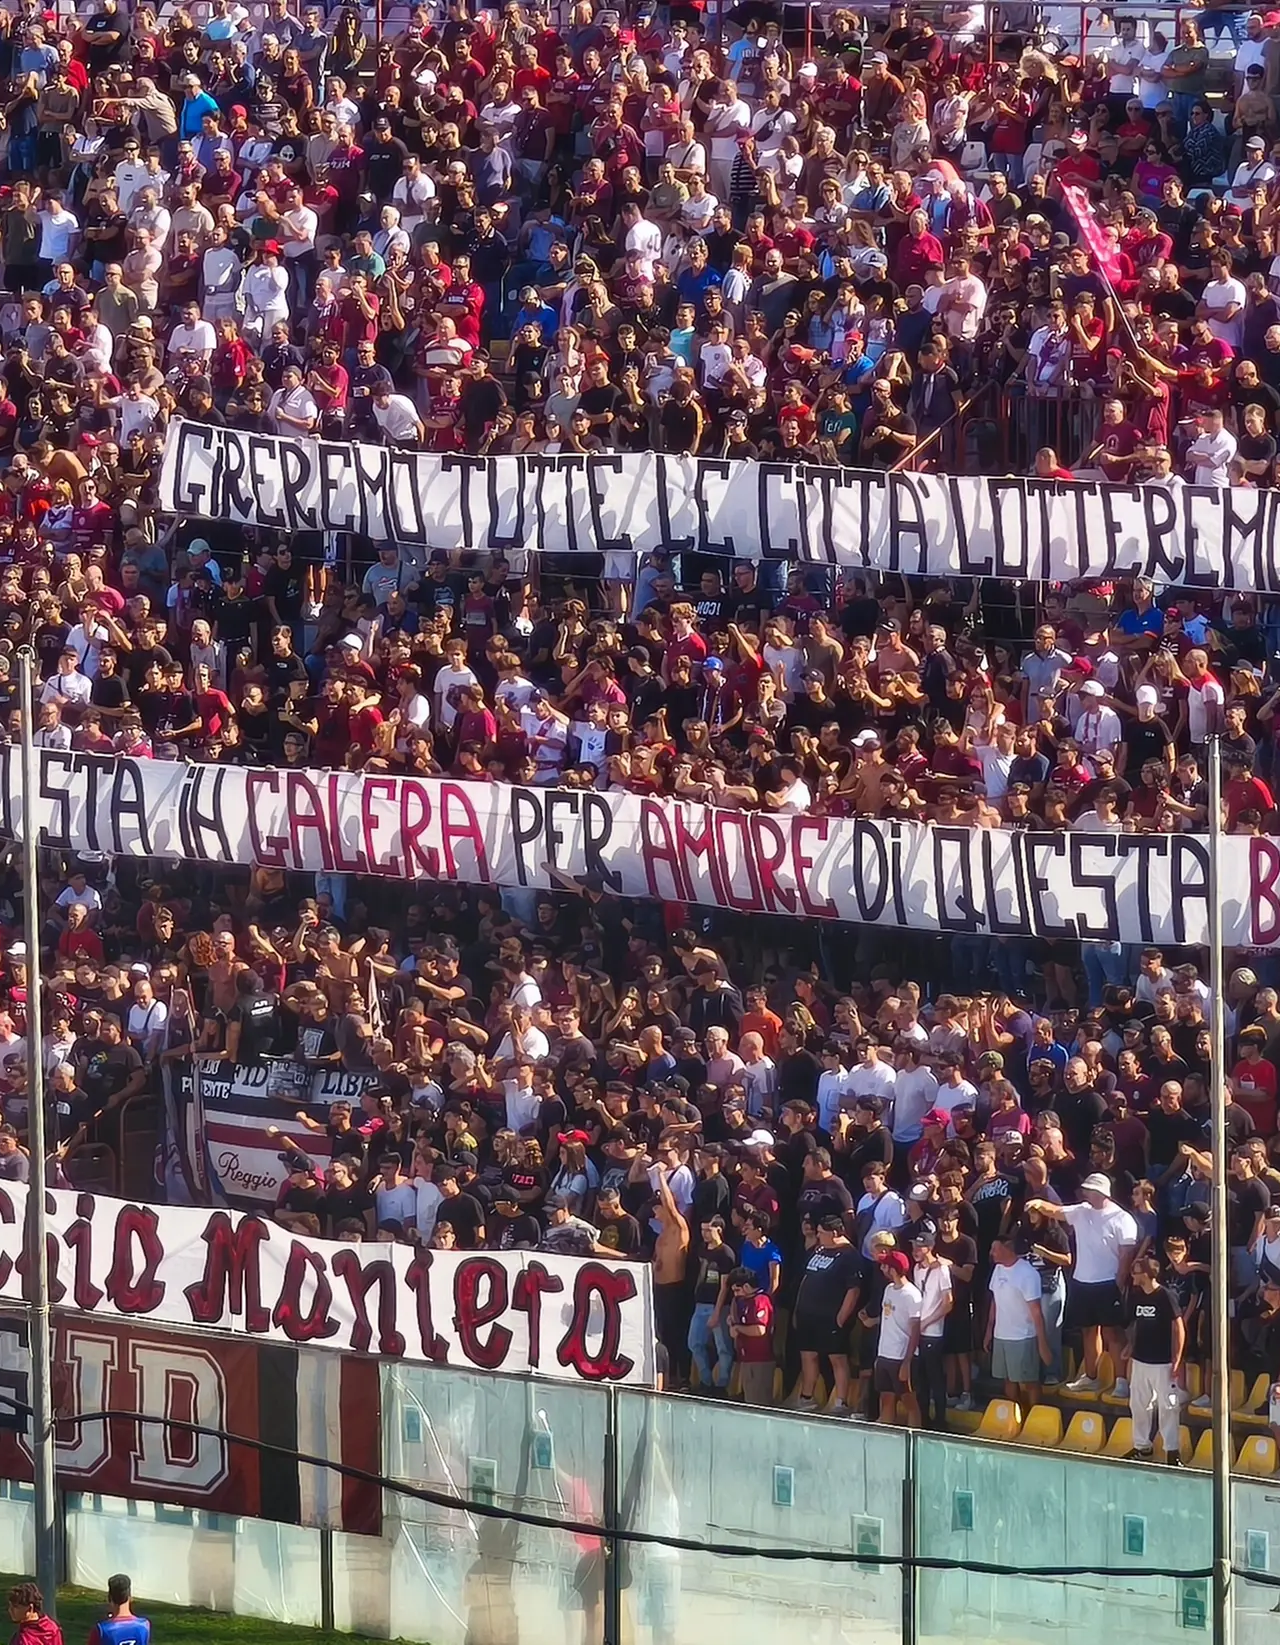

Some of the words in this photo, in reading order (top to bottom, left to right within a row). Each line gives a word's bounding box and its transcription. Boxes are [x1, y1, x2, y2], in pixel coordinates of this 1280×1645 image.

[441, 453, 631, 551] TUTTE
[656, 455, 735, 557] LE
[39, 748, 154, 856] STA
[246, 768, 492, 883] GALERA
[512, 788, 621, 889] PER
[640, 803, 839, 918] AMORE
[933, 827, 1210, 943] QUESTA
[218, 1152, 277, 1190] Reggio
